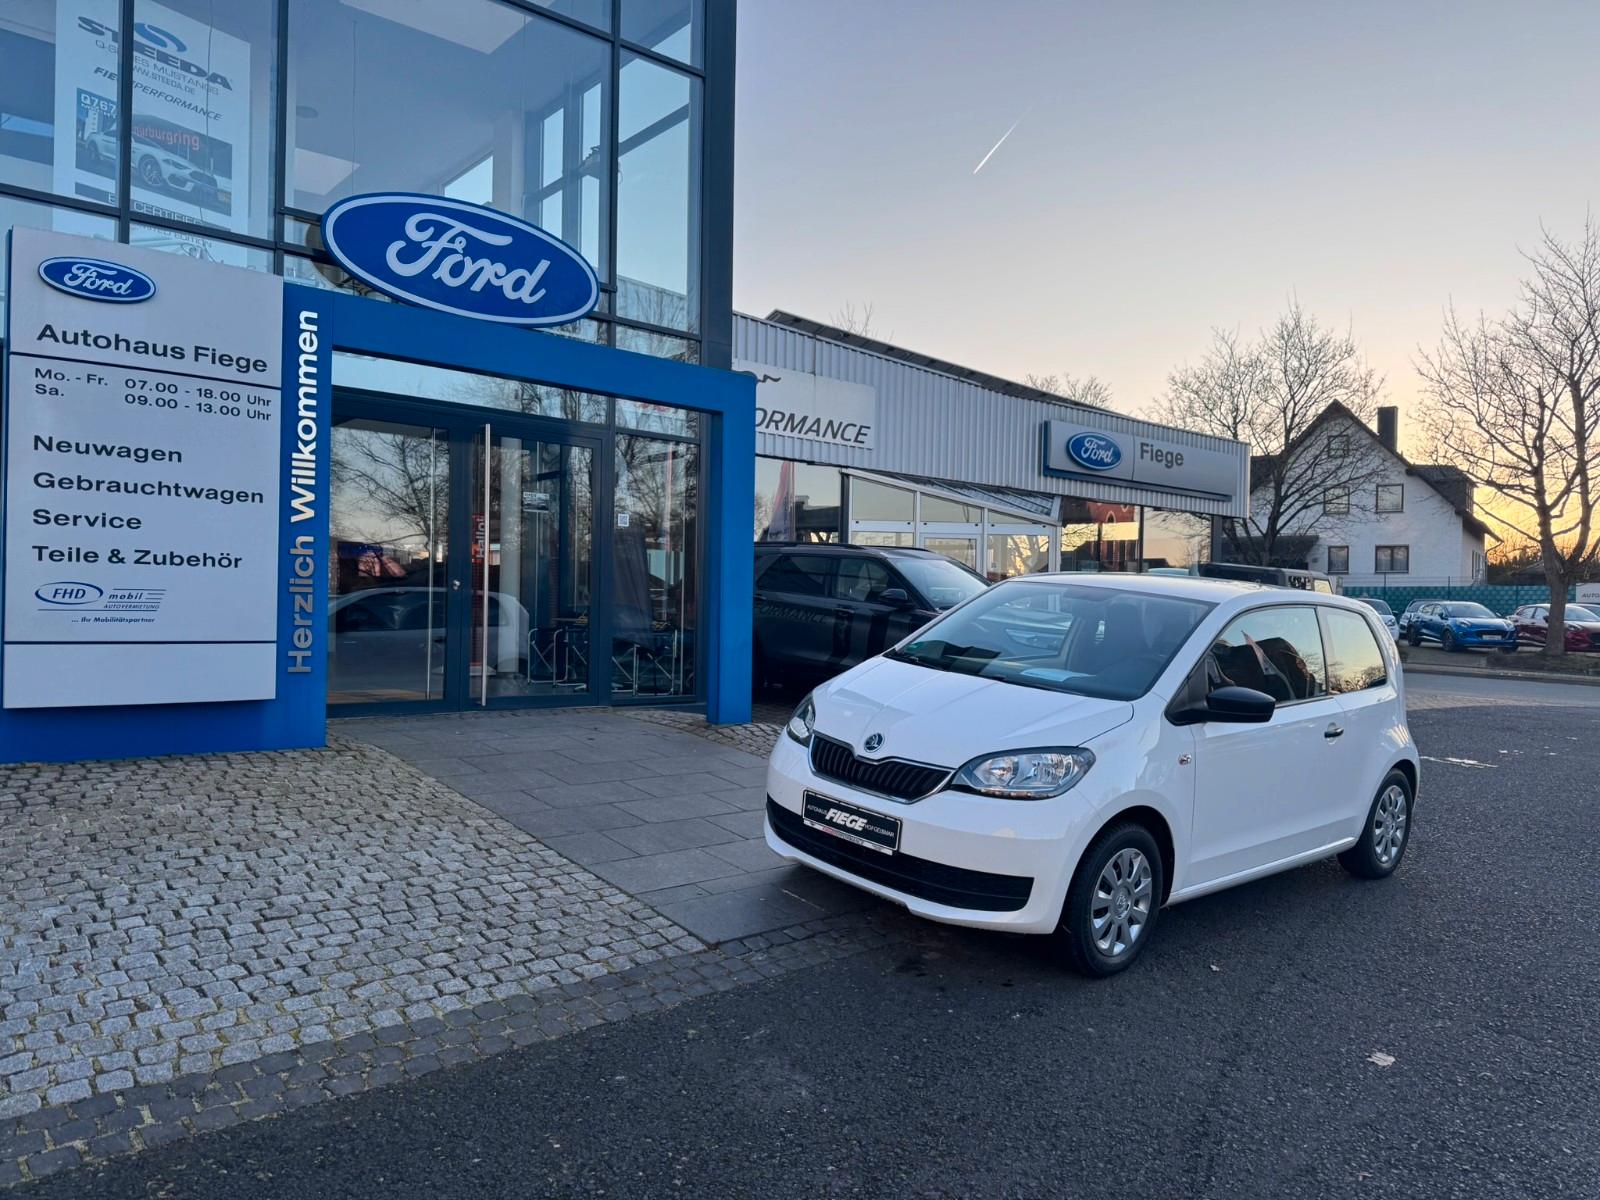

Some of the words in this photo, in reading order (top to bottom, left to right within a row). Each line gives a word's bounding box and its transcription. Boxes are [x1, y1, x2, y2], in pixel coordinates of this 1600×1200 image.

[78, 16, 233, 91] STEEDA
[386, 213, 550, 304] Ford
[63, 264, 133, 295] Ford
[37, 324, 185, 360] Autohaus
[194, 345, 268, 374] Fiege
[35, 368, 70, 382] Mo.
[87, 374, 108, 386] Fr.
[125, 378, 178, 395] 07.00
[196, 387, 241, 403] 18.00
[247, 394, 272, 407] Uhr
[35, 384, 65, 397] Sa.
[124, 393, 178, 409] 09.00
[196, 402, 241, 418] 13.00
[246, 408, 272, 421] Uhr
[291, 310, 318, 523] Willkommen
[755, 407, 871, 445] ORMANCE
[33, 435, 183, 463] Neuwagen
[1081, 437, 1114, 463] Ford
[1140, 442, 1184, 469] Fiege
[33, 472, 264, 505] Gebrauchtwagen
[32, 509, 143, 530] Service
[32, 545, 100, 564] Teile
[107, 549, 126, 565] &
[133, 549, 243, 569] Zubehör
[52, 588, 87, 600] FHD
[108, 592, 143, 601] mobil
[287, 535, 315, 674] Herzlich
[93, 616, 155, 624] Mobilitätspartner
[825, 808, 867, 831] FIEGE
